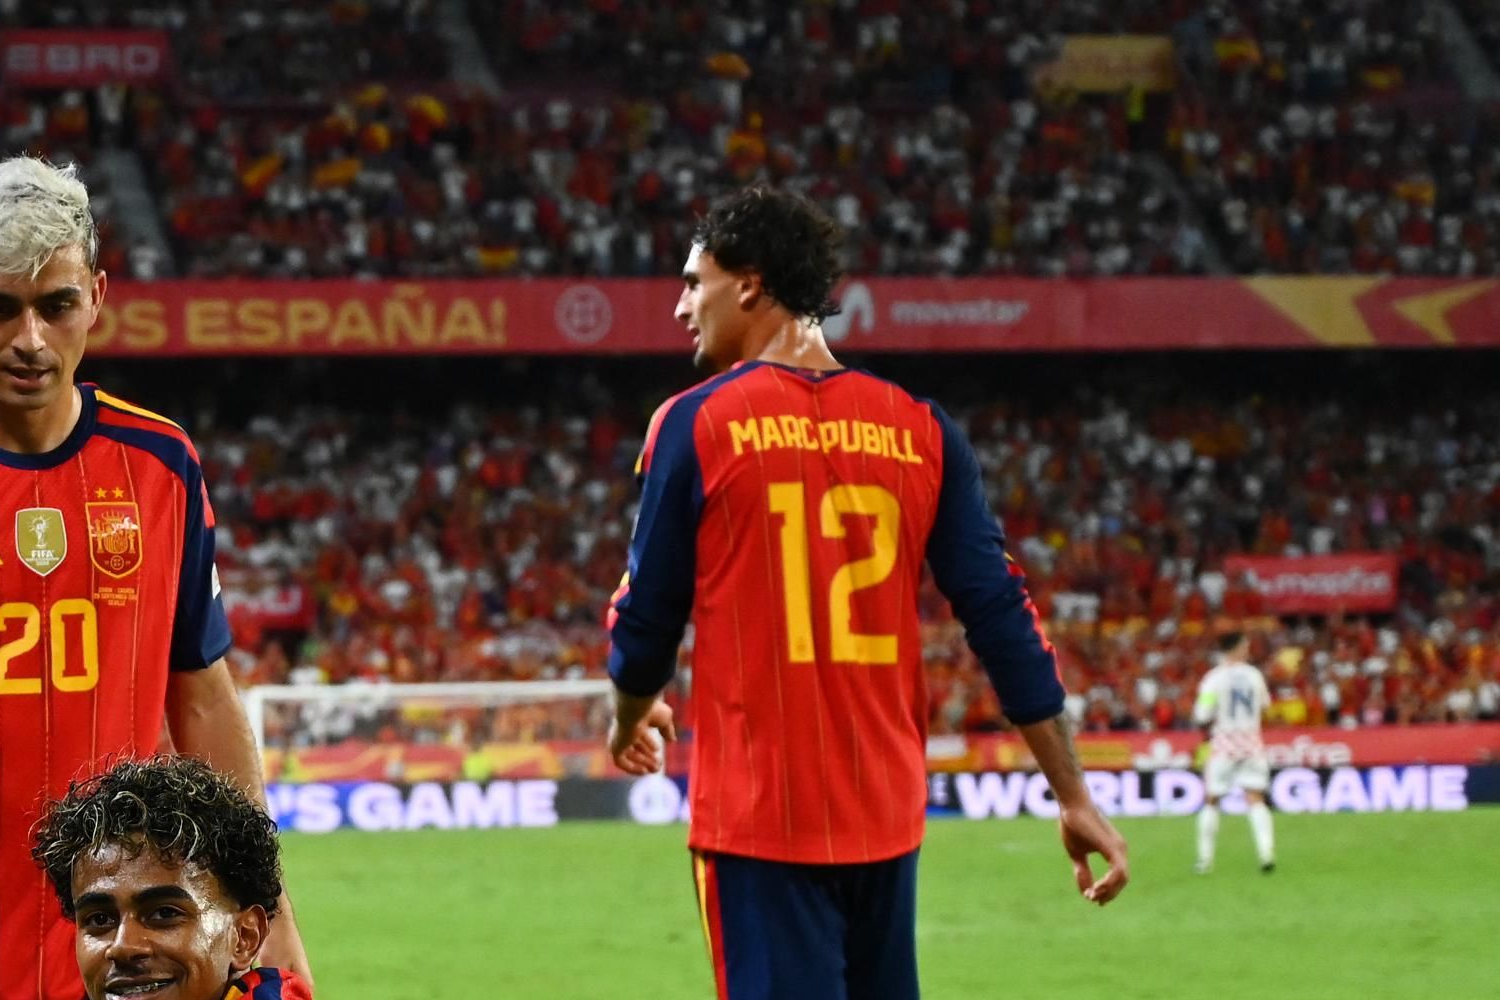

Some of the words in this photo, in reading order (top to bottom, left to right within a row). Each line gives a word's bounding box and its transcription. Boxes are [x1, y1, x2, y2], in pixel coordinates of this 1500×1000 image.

[185, 283, 506, 347] ESPAÑA!
[728, 415, 820, 456] MARC
[817, 420, 924, 465] PUBILL
[767, 482, 901, 666] 12
[347, 779, 559, 832] GAME
[955, 768, 1251, 821] WORLD
[1271, 764, 1470, 812] GAME
